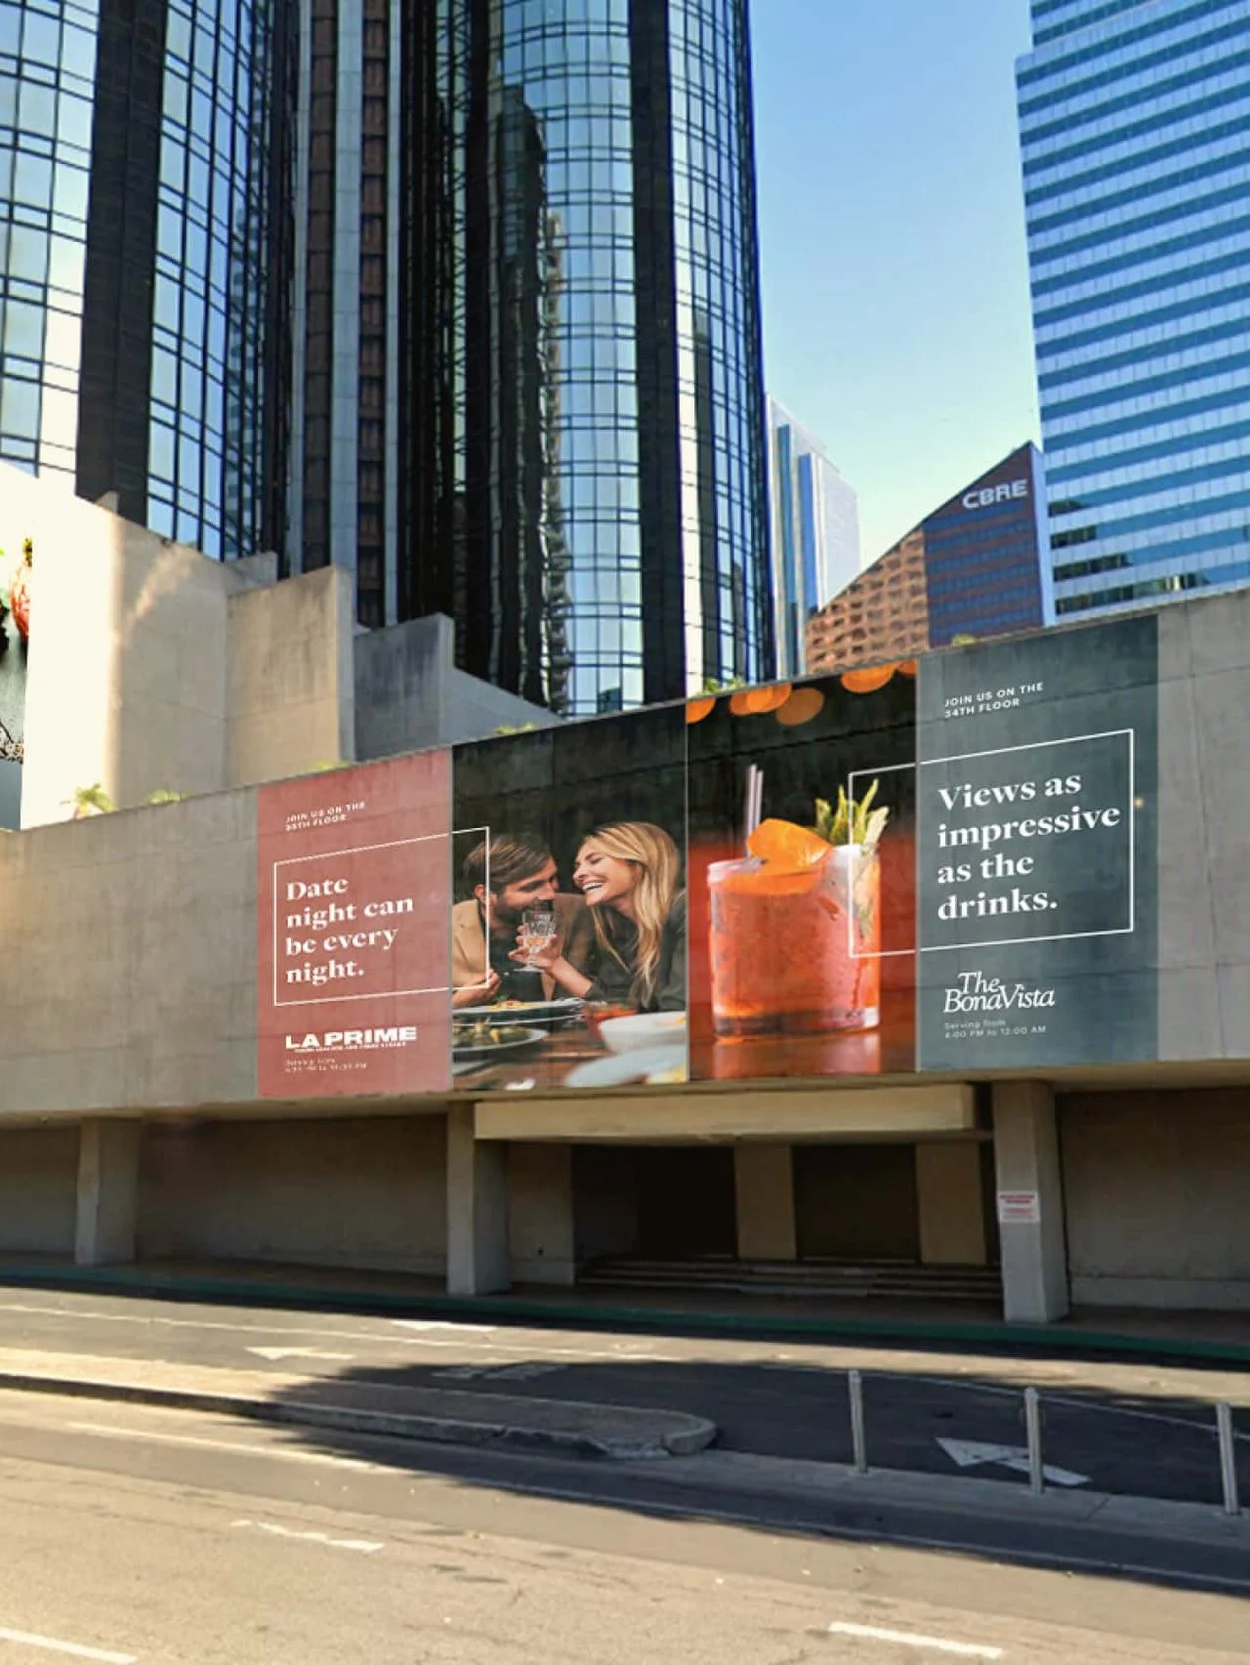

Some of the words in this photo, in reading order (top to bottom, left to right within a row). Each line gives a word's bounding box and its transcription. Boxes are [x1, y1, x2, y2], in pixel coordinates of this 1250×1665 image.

[962, 479, 1028, 509] CBRE
[944, 706, 975, 718] 34TH
[978, 698, 1020, 712] FLOOR
[945, 695, 972, 707] JOIN
[976, 691, 992, 702] US
[996, 688, 1015, 698] ON
[1020, 682, 1043, 694] THE
[938, 782, 1036, 811] Views
[1044, 774, 1082, 797] as
[938, 805, 1121, 850] impressive
[938, 863, 972, 884] as
[980, 853, 1034, 879] the
[286, 879, 349, 901] Date
[938, 887, 1058, 920] drinks.
[287, 902, 357, 931] night
[363, 897, 414, 917] can
[286, 937, 317, 956] be
[323, 928, 399, 950] every
[286, 959, 365, 986] night.
[957, 970, 1000, 994] The
[324, 1026, 417, 1046] PRIME
